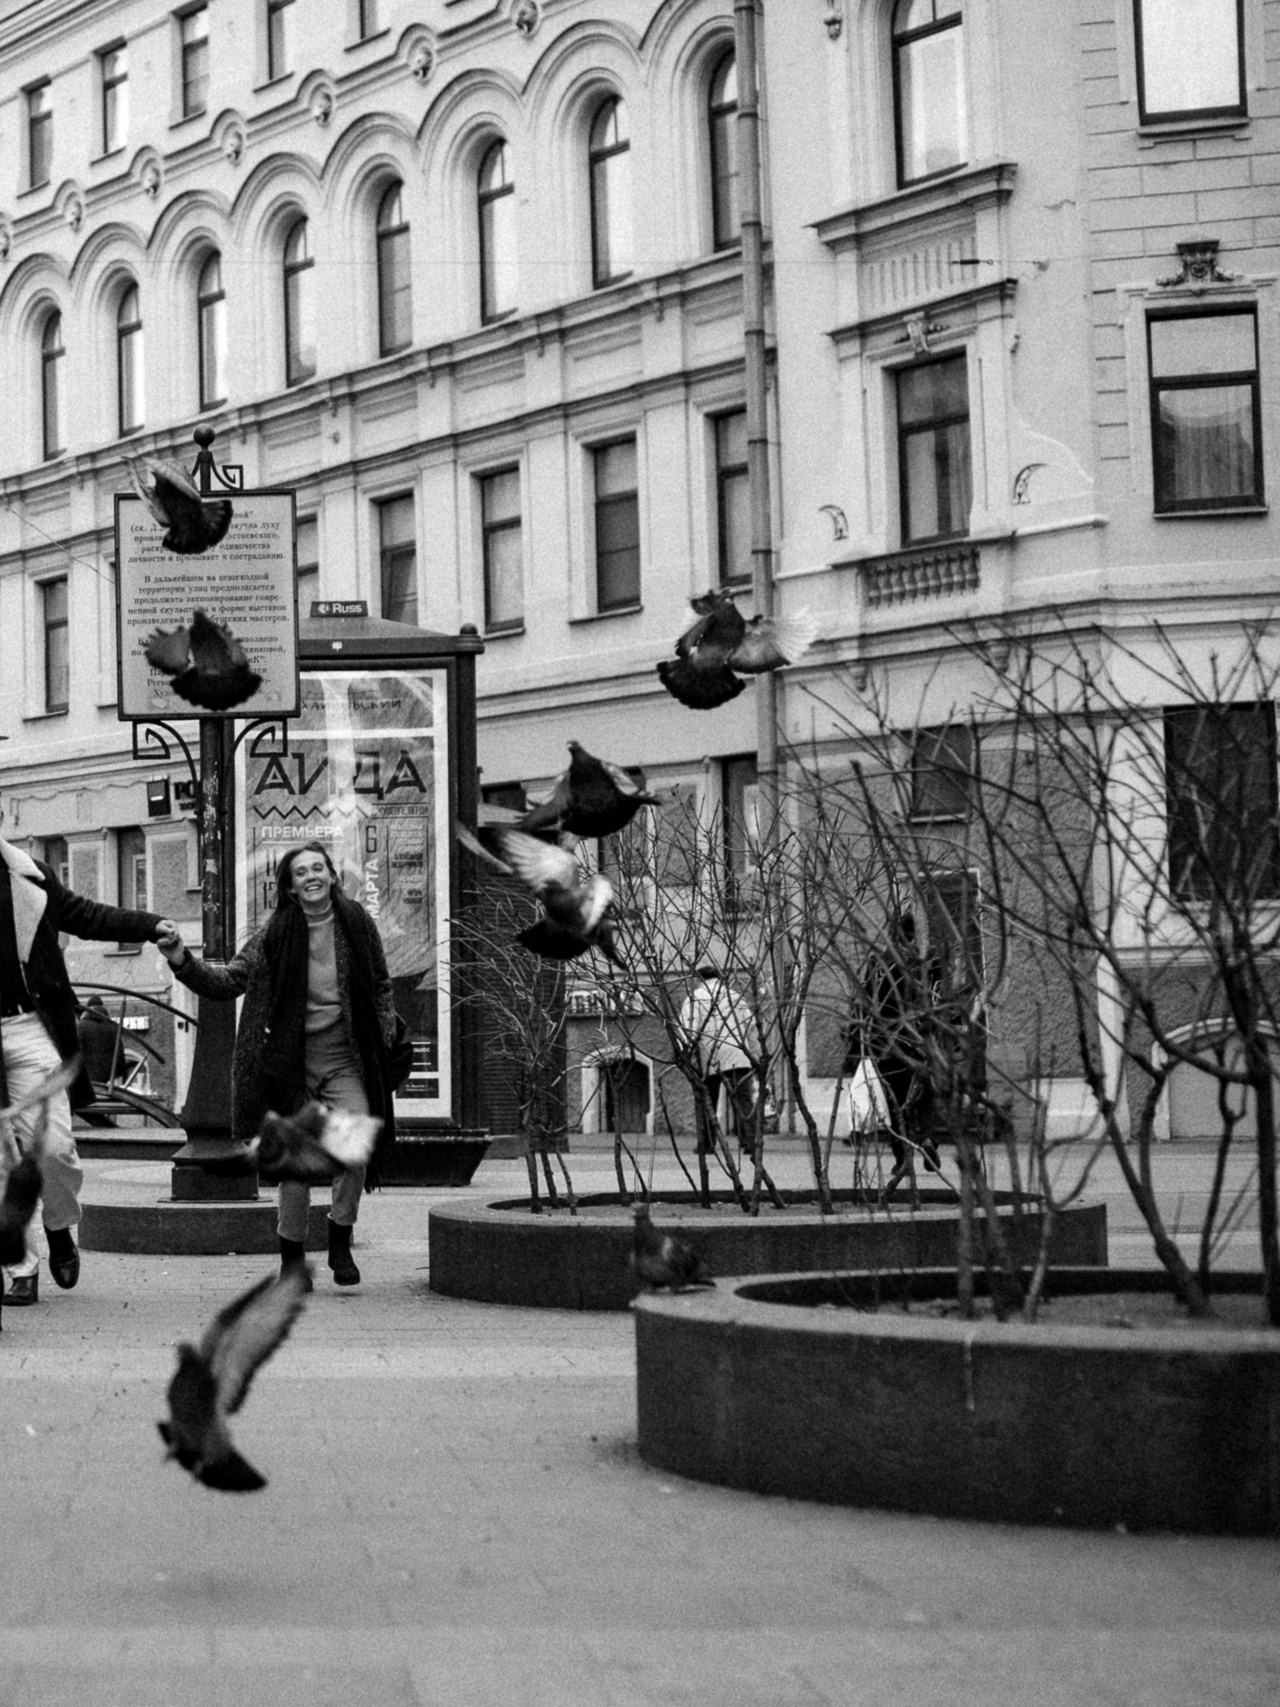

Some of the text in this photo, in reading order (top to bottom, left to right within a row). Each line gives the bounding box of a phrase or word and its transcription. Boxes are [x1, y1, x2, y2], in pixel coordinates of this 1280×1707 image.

[260, 522, 280, 531] духу
[227, 532, 280, 541] остоевского,
[128, 555, 166, 564] личности
[229, 553, 286, 561] состраданию.
[144, 575, 151, 583] В
[154, 574, 204, 583] дальнейшем
[219, 572, 269, 582] пешеходной
[139, 584, 275, 595] территории улиц предполагается
[134, 594, 282, 605] продолжить экспонирование совре-
[127, 607, 157, 615] менной
[219, 604, 246, 614] форме
[249, 604, 287, 612] выставок
[332, 603, 362, 613] Russ
[127, 616, 185, 626] произведений
[249, 614, 290, 623] мастеров.
[254, 750, 427, 800] АИДА
[261, 825, 343, 838] ПРЕМЬЕРА
[366, 825, 377, 853] 6
[366, 859, 380, 919] МАРТА
